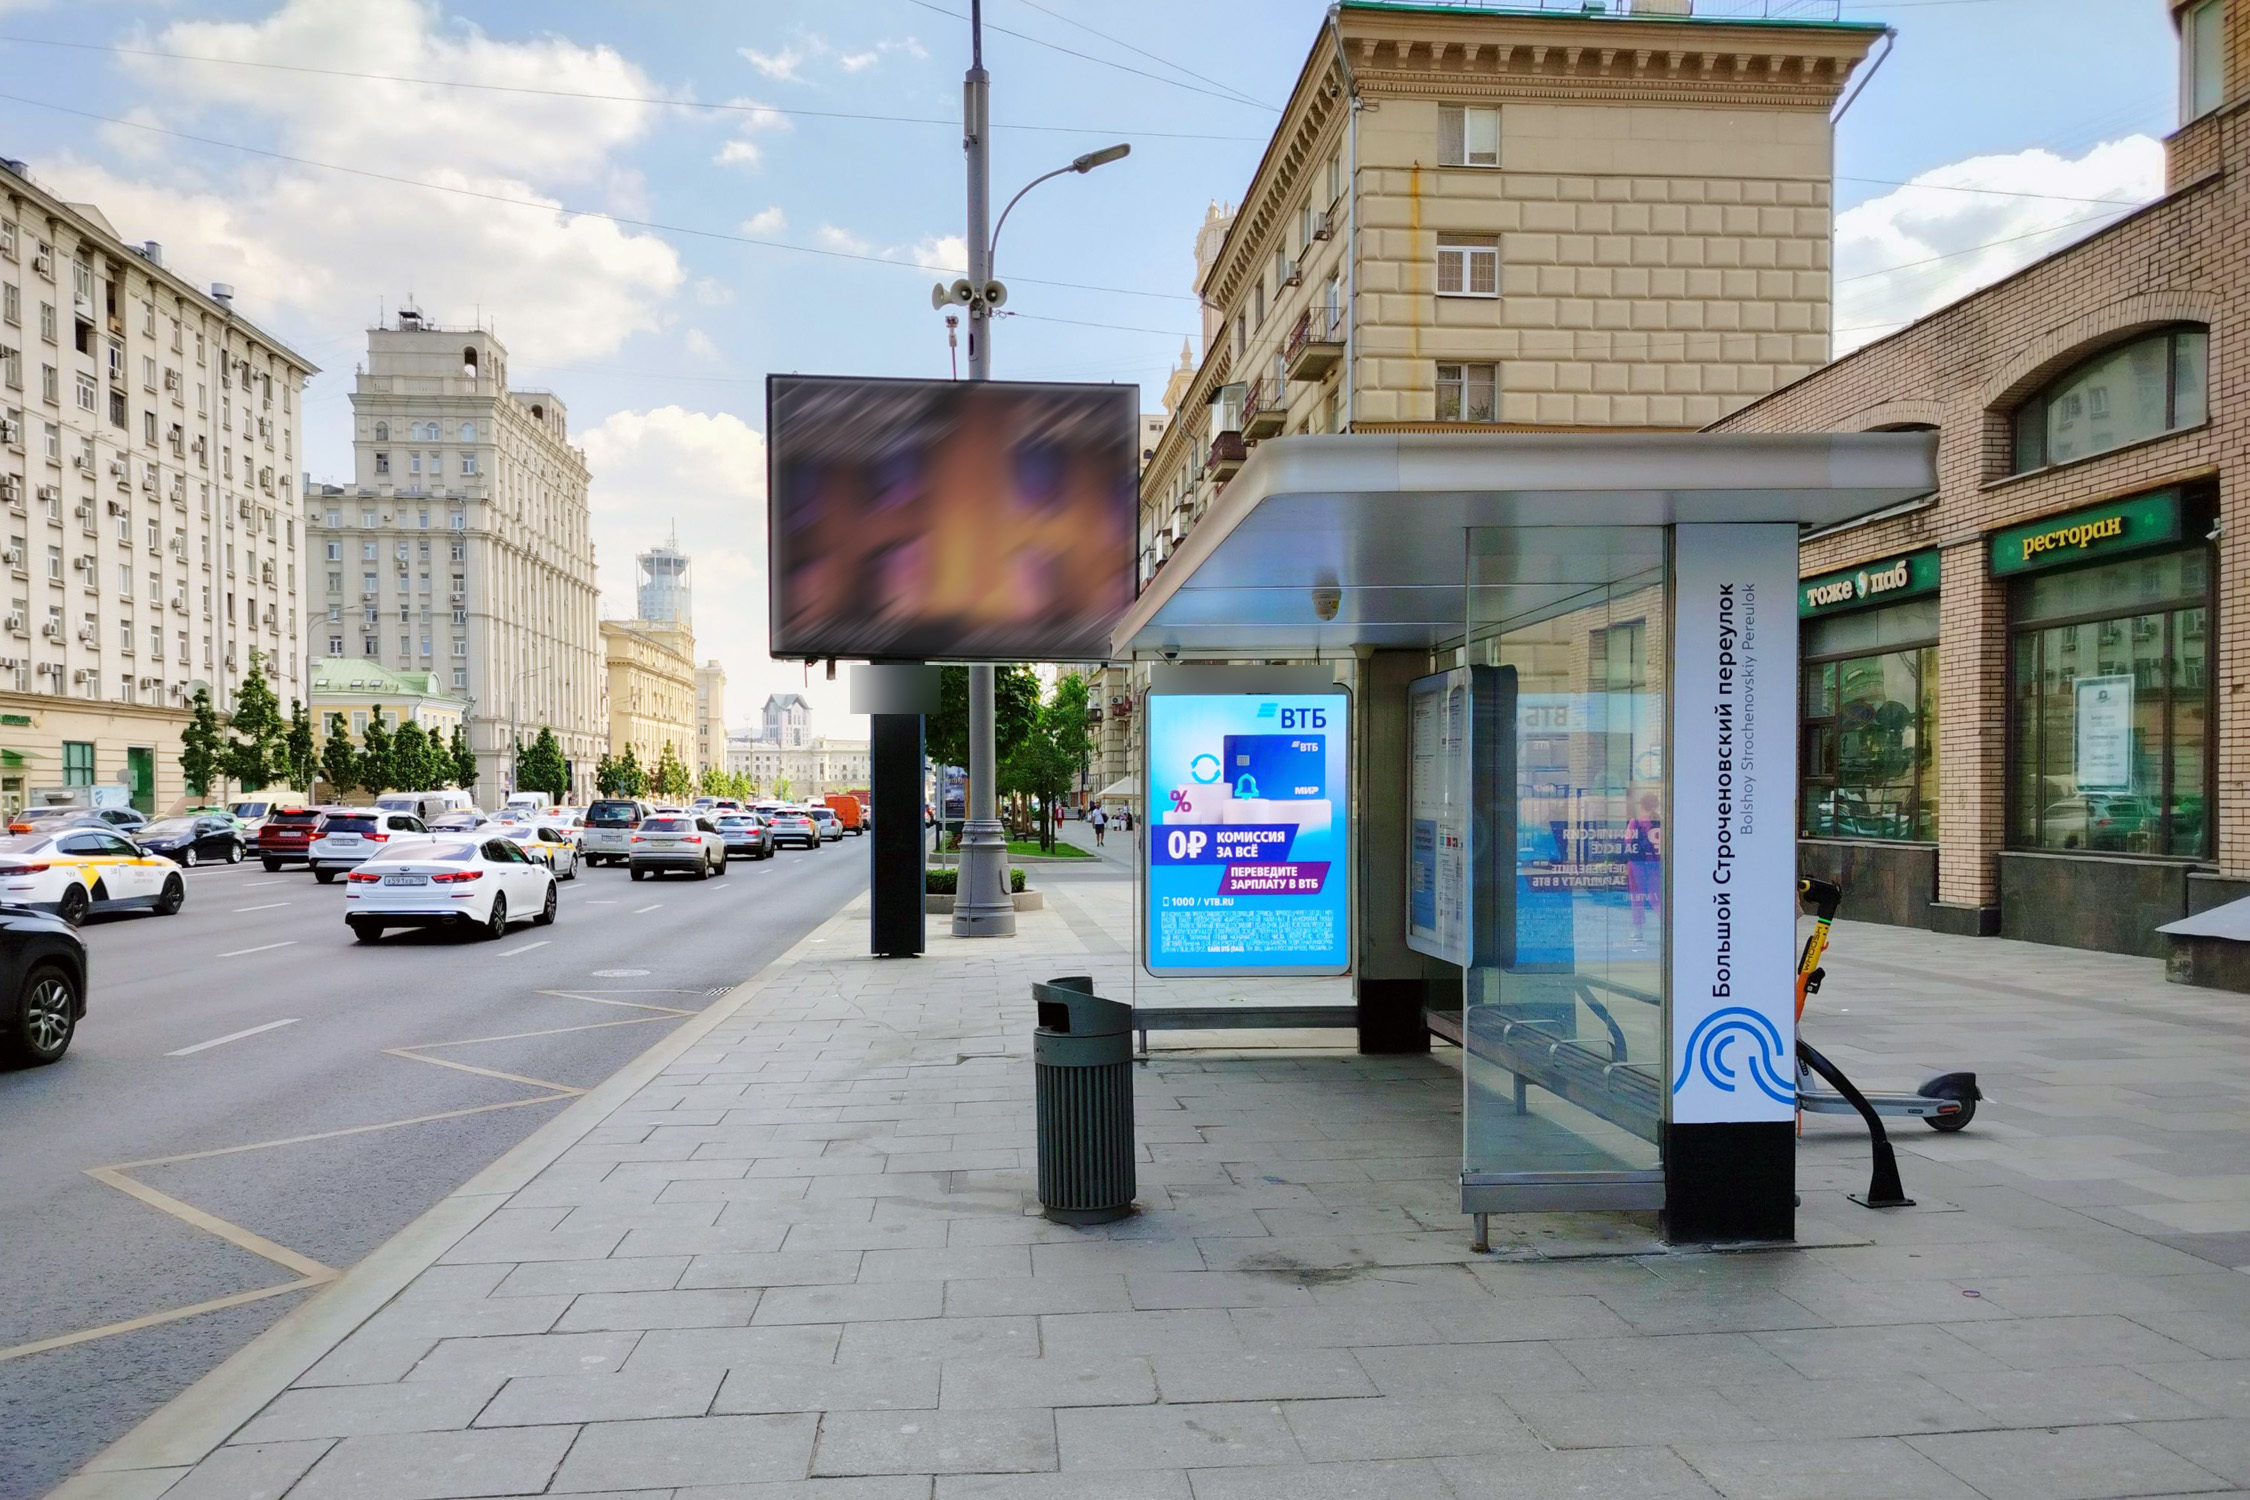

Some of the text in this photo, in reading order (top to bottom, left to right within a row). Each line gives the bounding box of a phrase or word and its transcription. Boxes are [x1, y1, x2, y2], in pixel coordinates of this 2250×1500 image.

[2022, 516, 2122, 560] ресторан
[1807, 560, 1908, 607] тоже паб
[1740, 583, 1757, 834] Bolshoy Strochenovskiy Pereulok
[1281, 708, 1327, 729] ВТБ
[1300, 742, 1319, 752] ВТБ
[1294, 786, 1319, 795] МИР
[1712, 583, 1738, 997] Большой Строченовский переулок
[1216, 831, 1285, 843] КОМИССИЯ
[1216, 844, 1259, 858] ЗА ВСЁ
[1230, 866, 1298, 879] ПЕРЕВЕДИТЕ
[1230, 878, 1319, 890] ЗАРПЛАТУ В ВТБ
[1171, 897, 1195, 907] 1000
[1203, 897, 1235, 907] VTB.RU
[1803, 926, 1823, 971] WHOOSH
